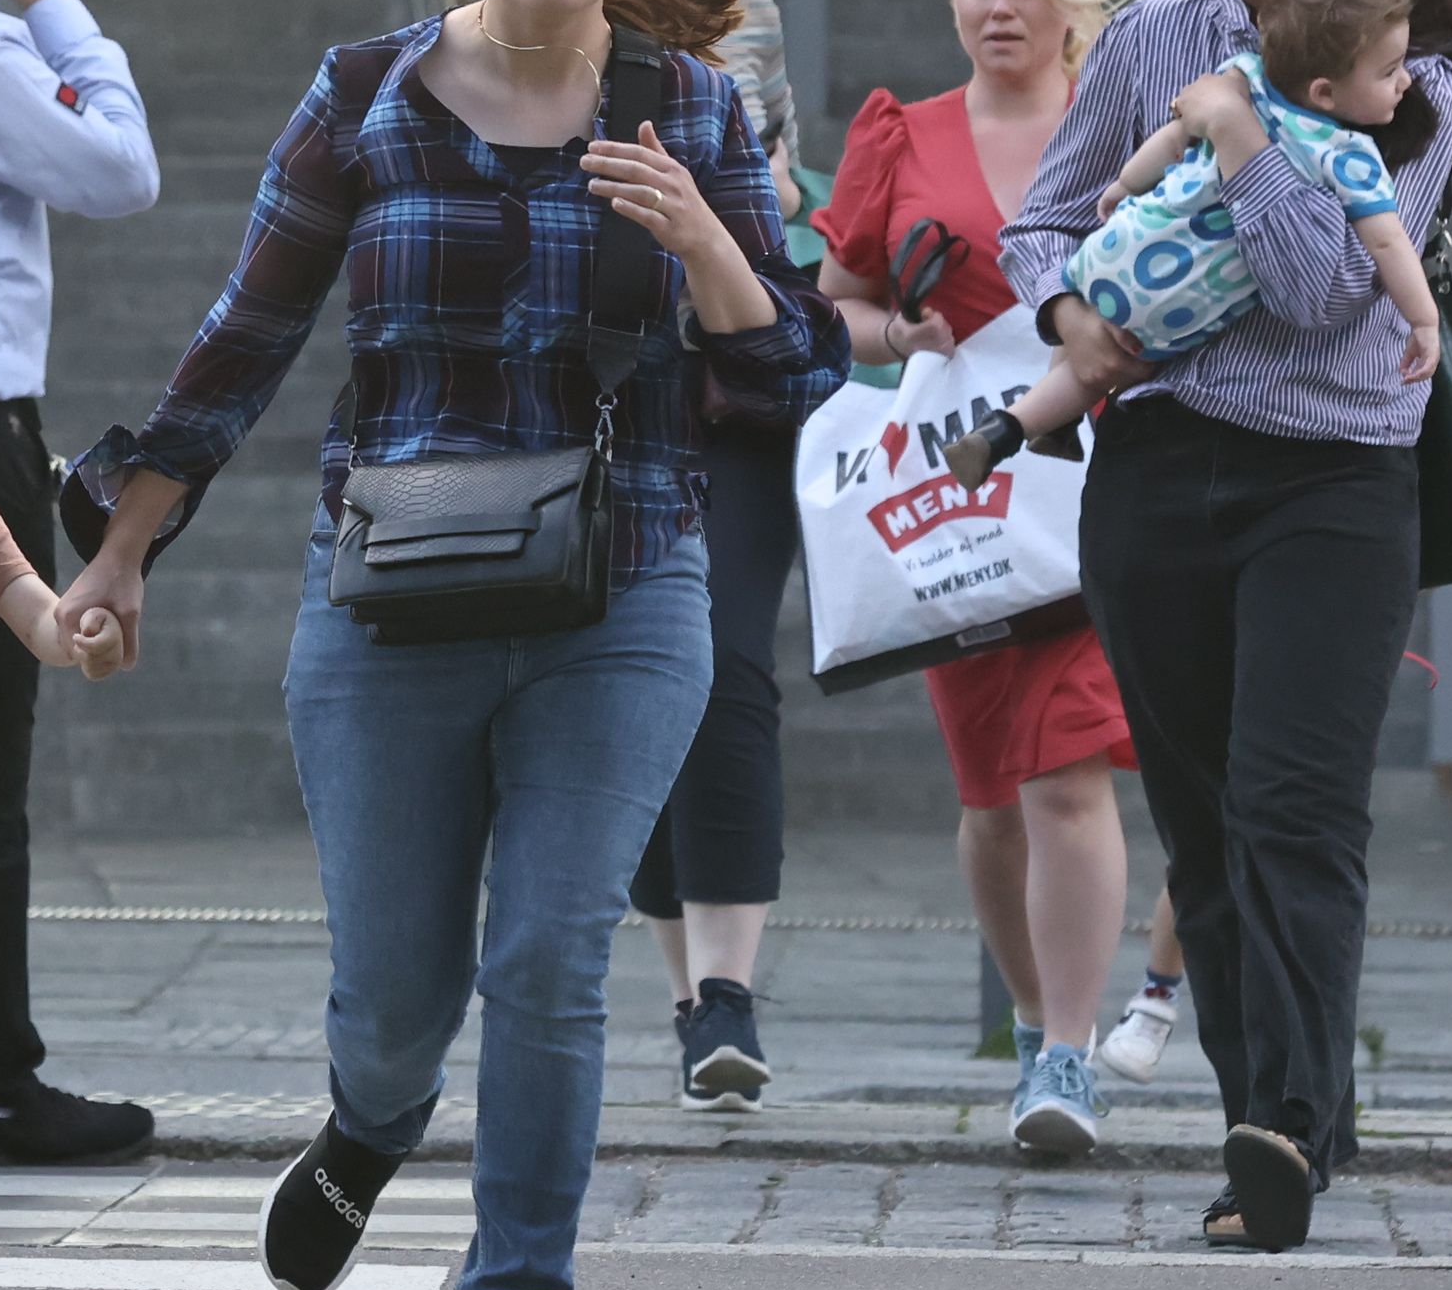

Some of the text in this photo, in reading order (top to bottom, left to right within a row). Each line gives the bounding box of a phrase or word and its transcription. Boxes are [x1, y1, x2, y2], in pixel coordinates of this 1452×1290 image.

[883, 479, 999, 539] MENY
[918, 546, 954, 568] holder
[976, 523, 1004, 545] mad
[913, 557, 1014, 602] WWW.MENY.DK
[314, 1167, 366, 1229] adidas
